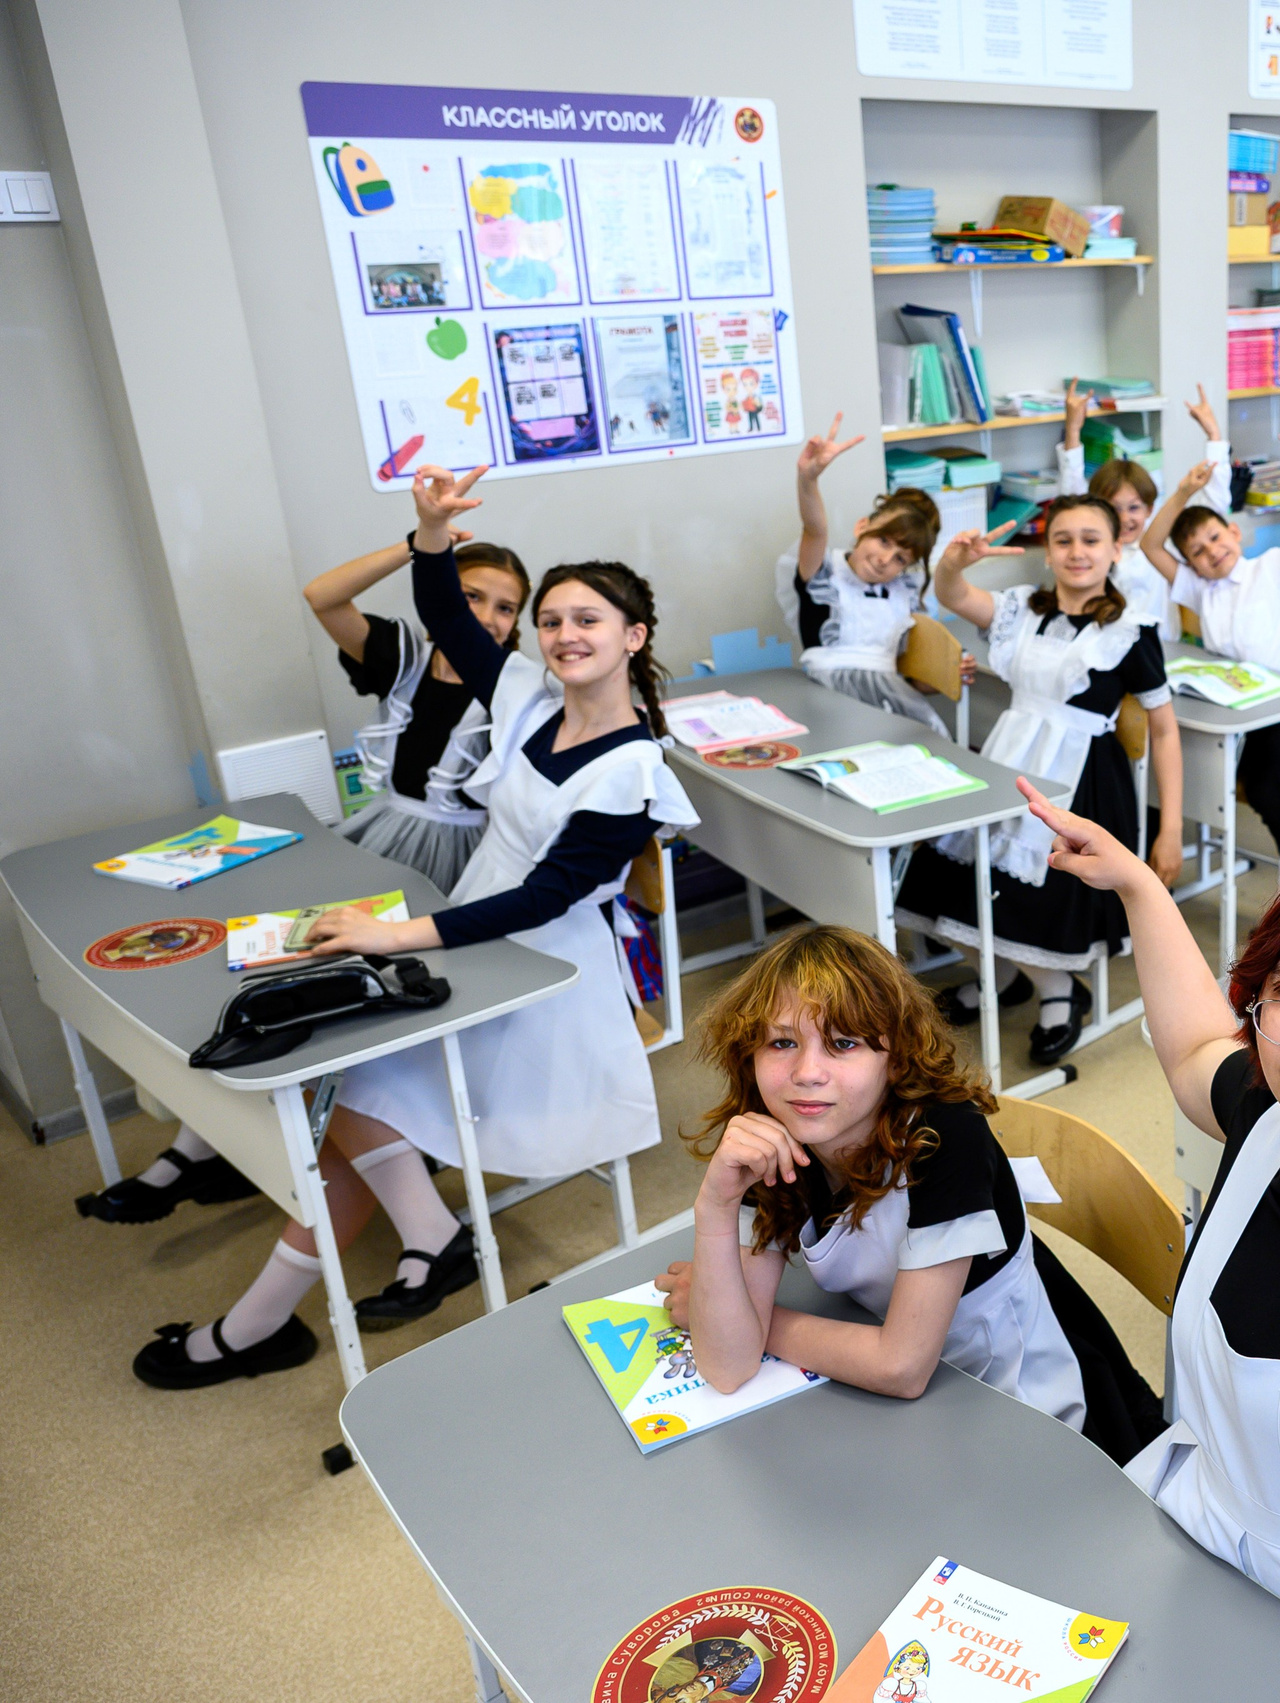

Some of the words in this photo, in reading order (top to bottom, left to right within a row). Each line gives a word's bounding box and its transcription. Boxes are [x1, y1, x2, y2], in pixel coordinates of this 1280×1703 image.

[442, 103, 577, 131] КЛАССНЫЙ
[580, 108, 666, 133] УГОЛОК
[445, 376, 482, 426] 4
[584, 1317, 650, 1374] 4
[720, 1591, 751, 1602] СОШ
[755, 1591, 793, 1609] район
[612, 1608, 680, 1666] Суворова
[793, 1604, 828, 1642] Динской
[912, 1595, 1024, 1658] Русский
[818, 1642, 829, 1659] МО
[811, 1660, 829, 1695] МАОУ
